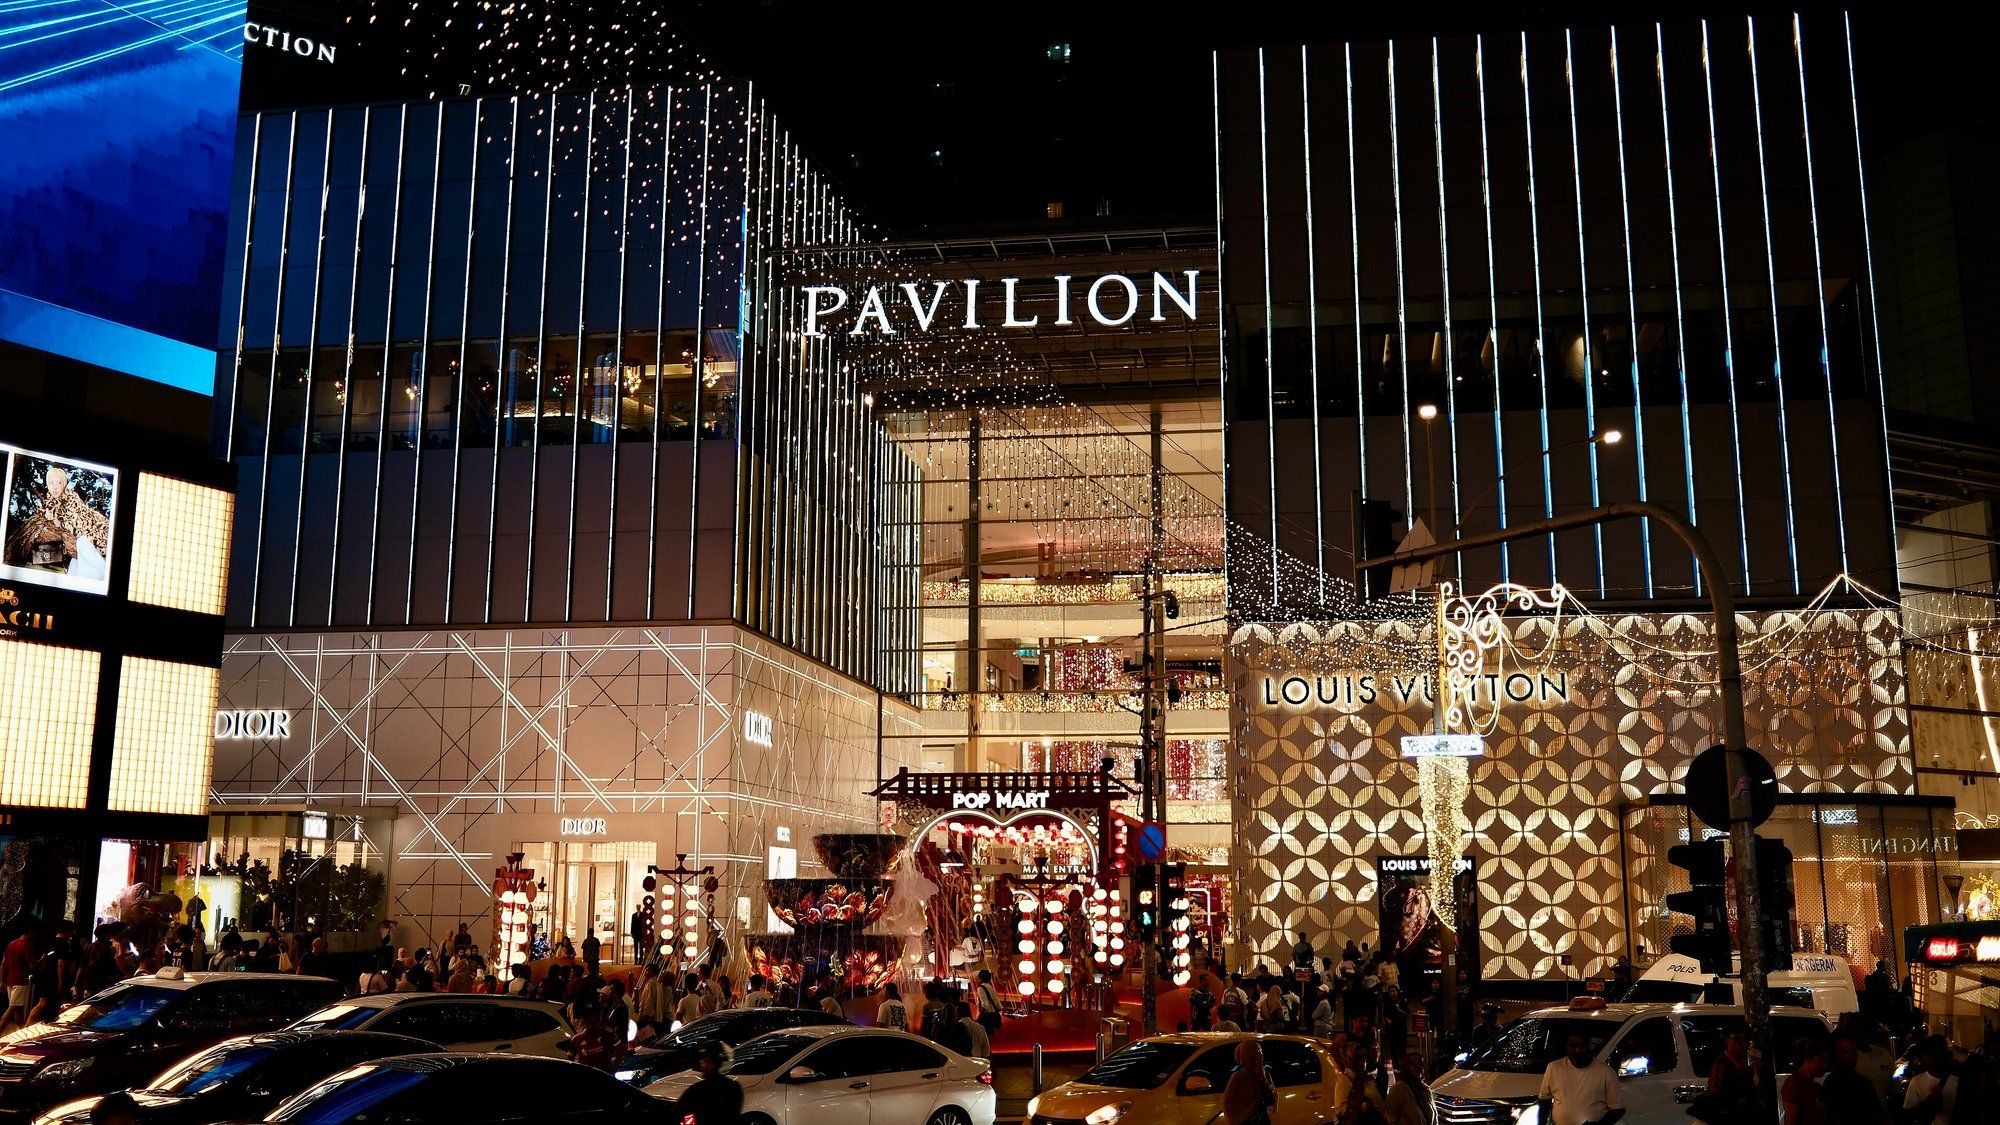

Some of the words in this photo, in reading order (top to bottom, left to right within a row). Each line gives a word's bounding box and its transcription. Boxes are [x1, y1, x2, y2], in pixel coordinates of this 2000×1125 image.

[243, 21, 337, 65] CTION
[800, 269, 1201, 338] PAVILION
[1264, 675, 1377, 705] LOUIS
[215, 710, 291, 739] DIOR
[952, 793, 991, 809] POP
[996, 792, 1050, 809] MART
[561, 818, 607, 835] DIOR
[1022, 865, 1049, 874] MAN
[1382, 859, 1417, 871] LOUIS
[1667, 964, 1697, 974] POLIS
